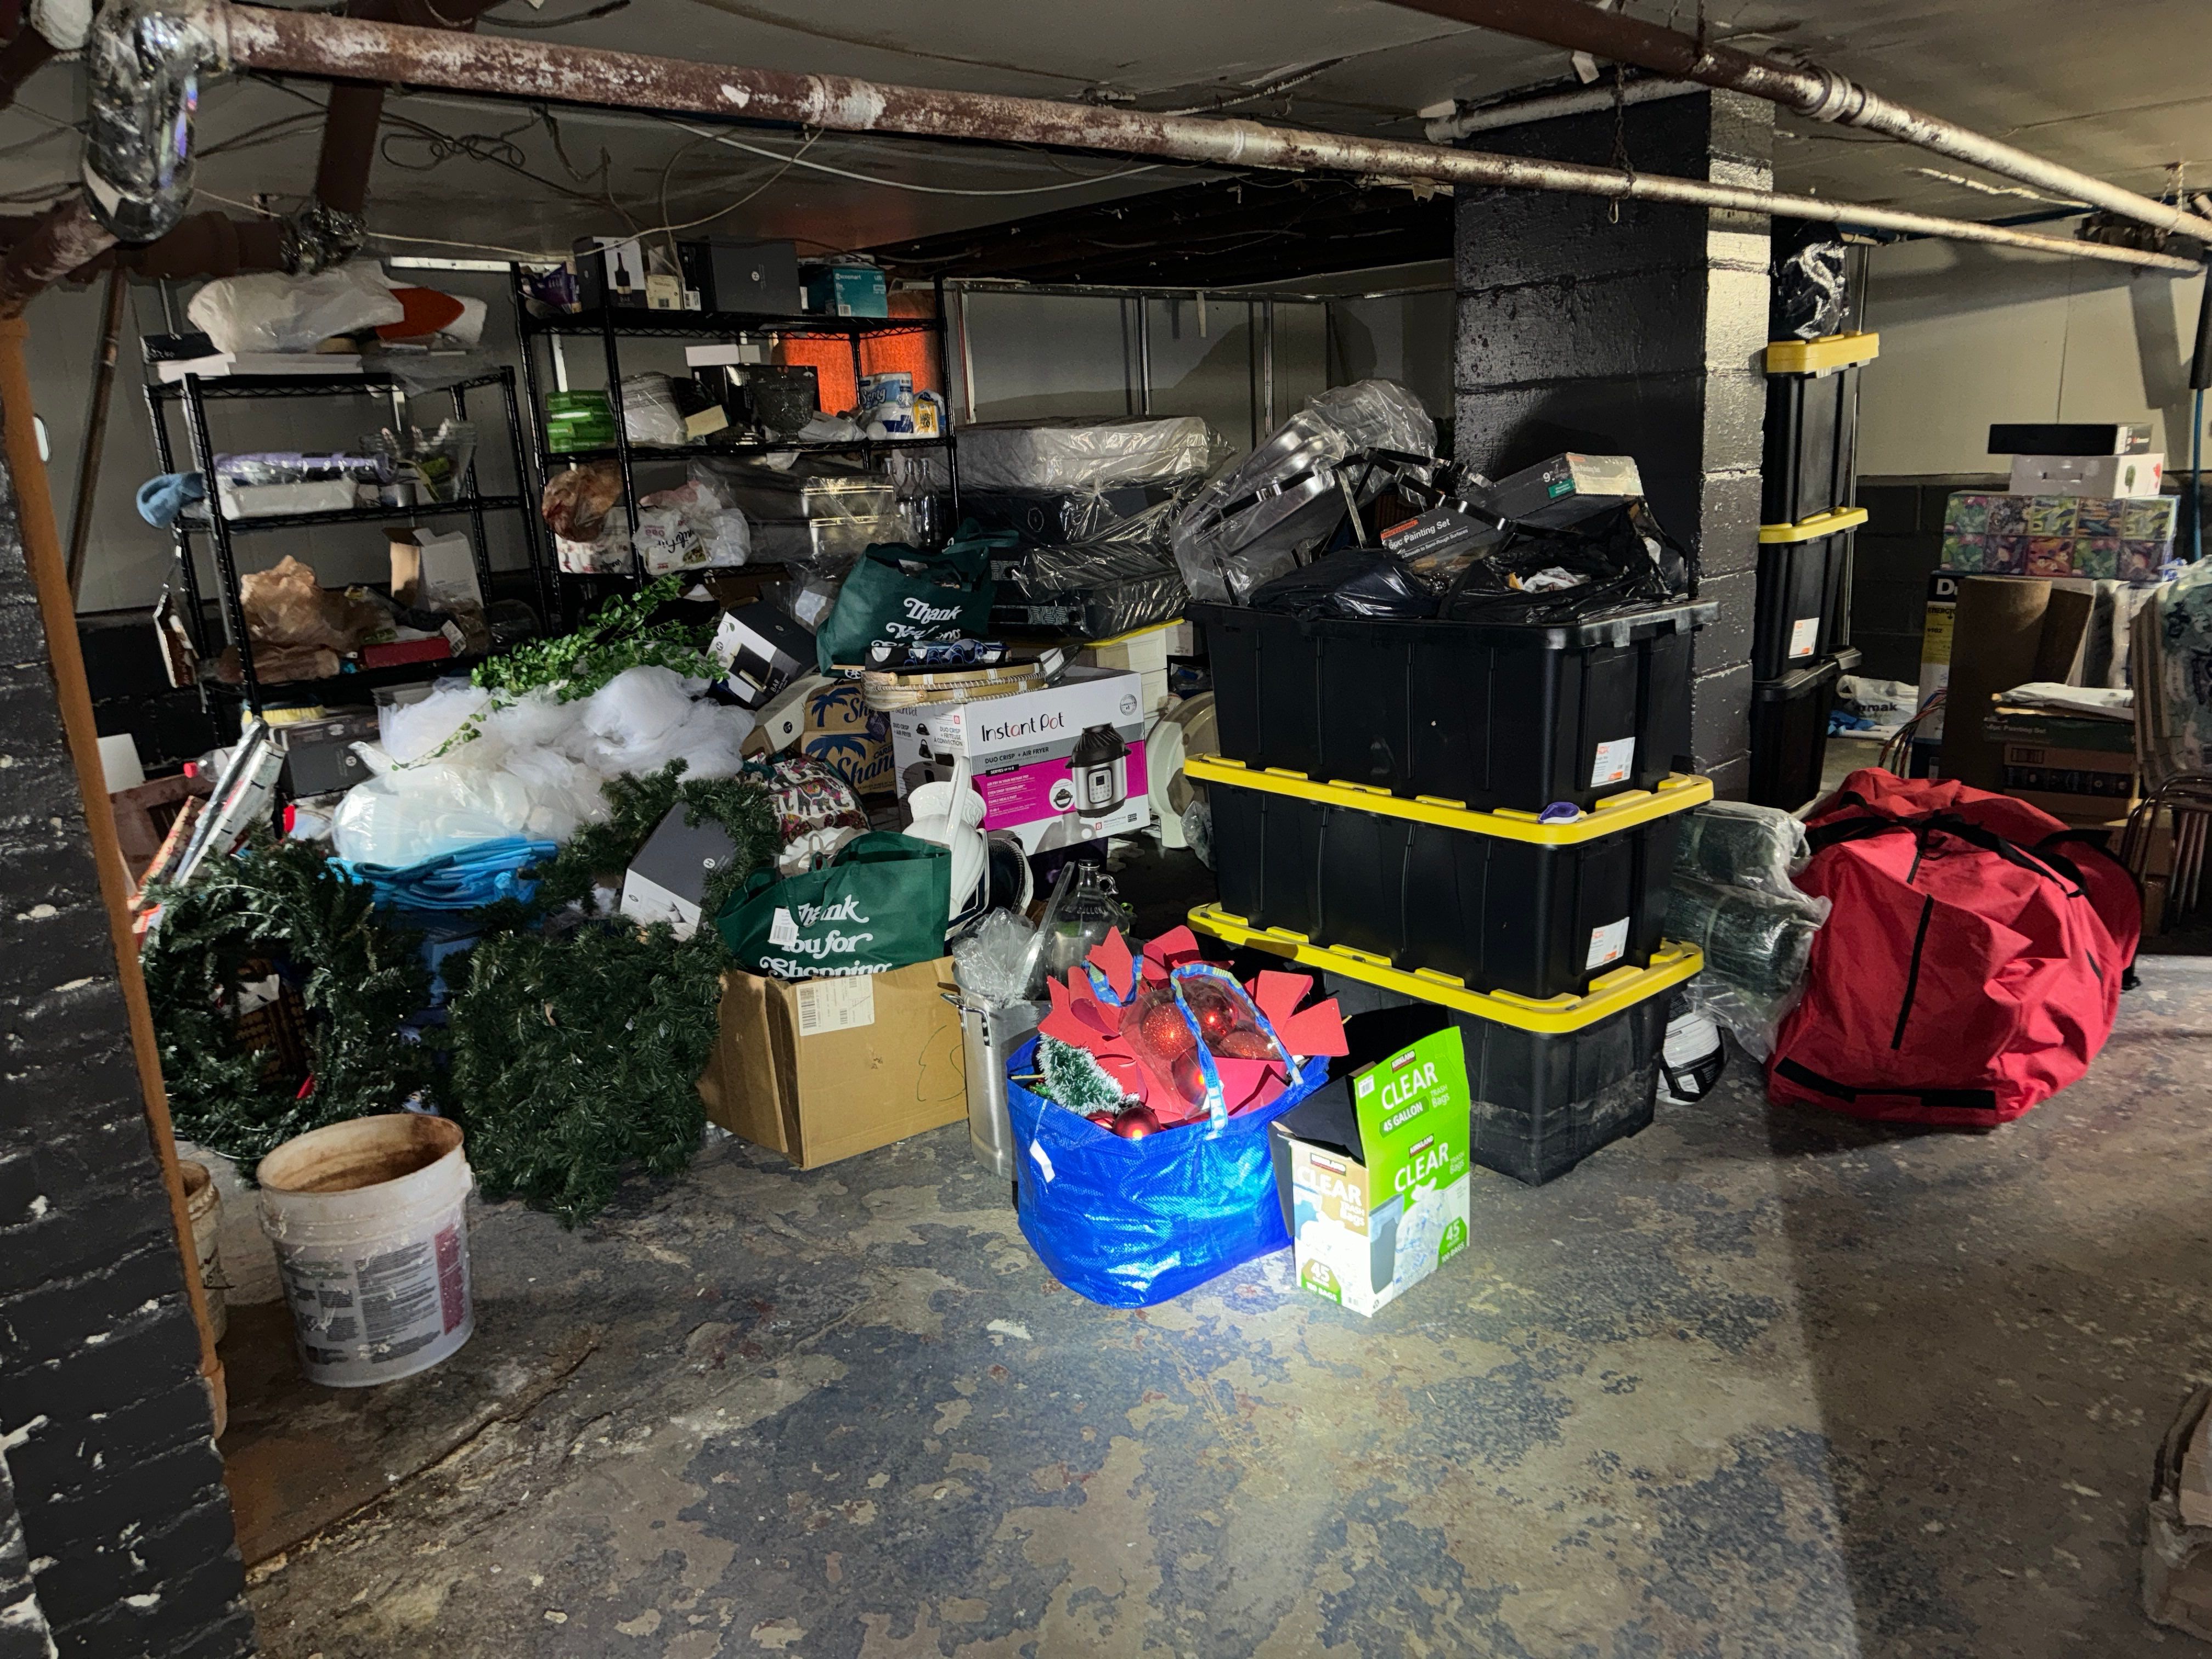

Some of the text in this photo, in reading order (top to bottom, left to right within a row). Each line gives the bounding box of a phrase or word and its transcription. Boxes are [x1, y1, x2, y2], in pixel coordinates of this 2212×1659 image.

[1403, 525, 1436, 543] Painting
[1436, 518, 1451, 530] Set
[1449, 529, 1469, 540] Surfaces
[904, 597, 963, 624] Thank
[981, 712, 1064, 742] Instant Pot
[937, 738, 963, 747] CONVECTION
[1032, 747, 1049, 755] FRYER
[812, 930, 873, 960] for
[1392, 1050, 1415, 1069] KIRKLAND
[1381, 1062, 1439, 1110] CLEAR
[1430, 1084, 1448, 1097] TRASH
[1431, 1093, 1451, 1108] Bags
[1383, 1101, 1424, 1132] 45 GALLON
[1409, 1135, 1434, 1155] KIRKLAND
[1395, 1142, 1449, 1192] CLEAR
[1449, 1159, 1465, 1175] Bags
[1296, 1166, 1363, 1207] CLEAR
[1340, 1200, 1365, 1216] TRASH
[1340, 1208, 1365, 1227] Bags
[1446, 1220, 1460, 1240] 45
[1450, 1240, 1465, 1257] BAGS
[1311, 1262, 1330, 1283] 45
